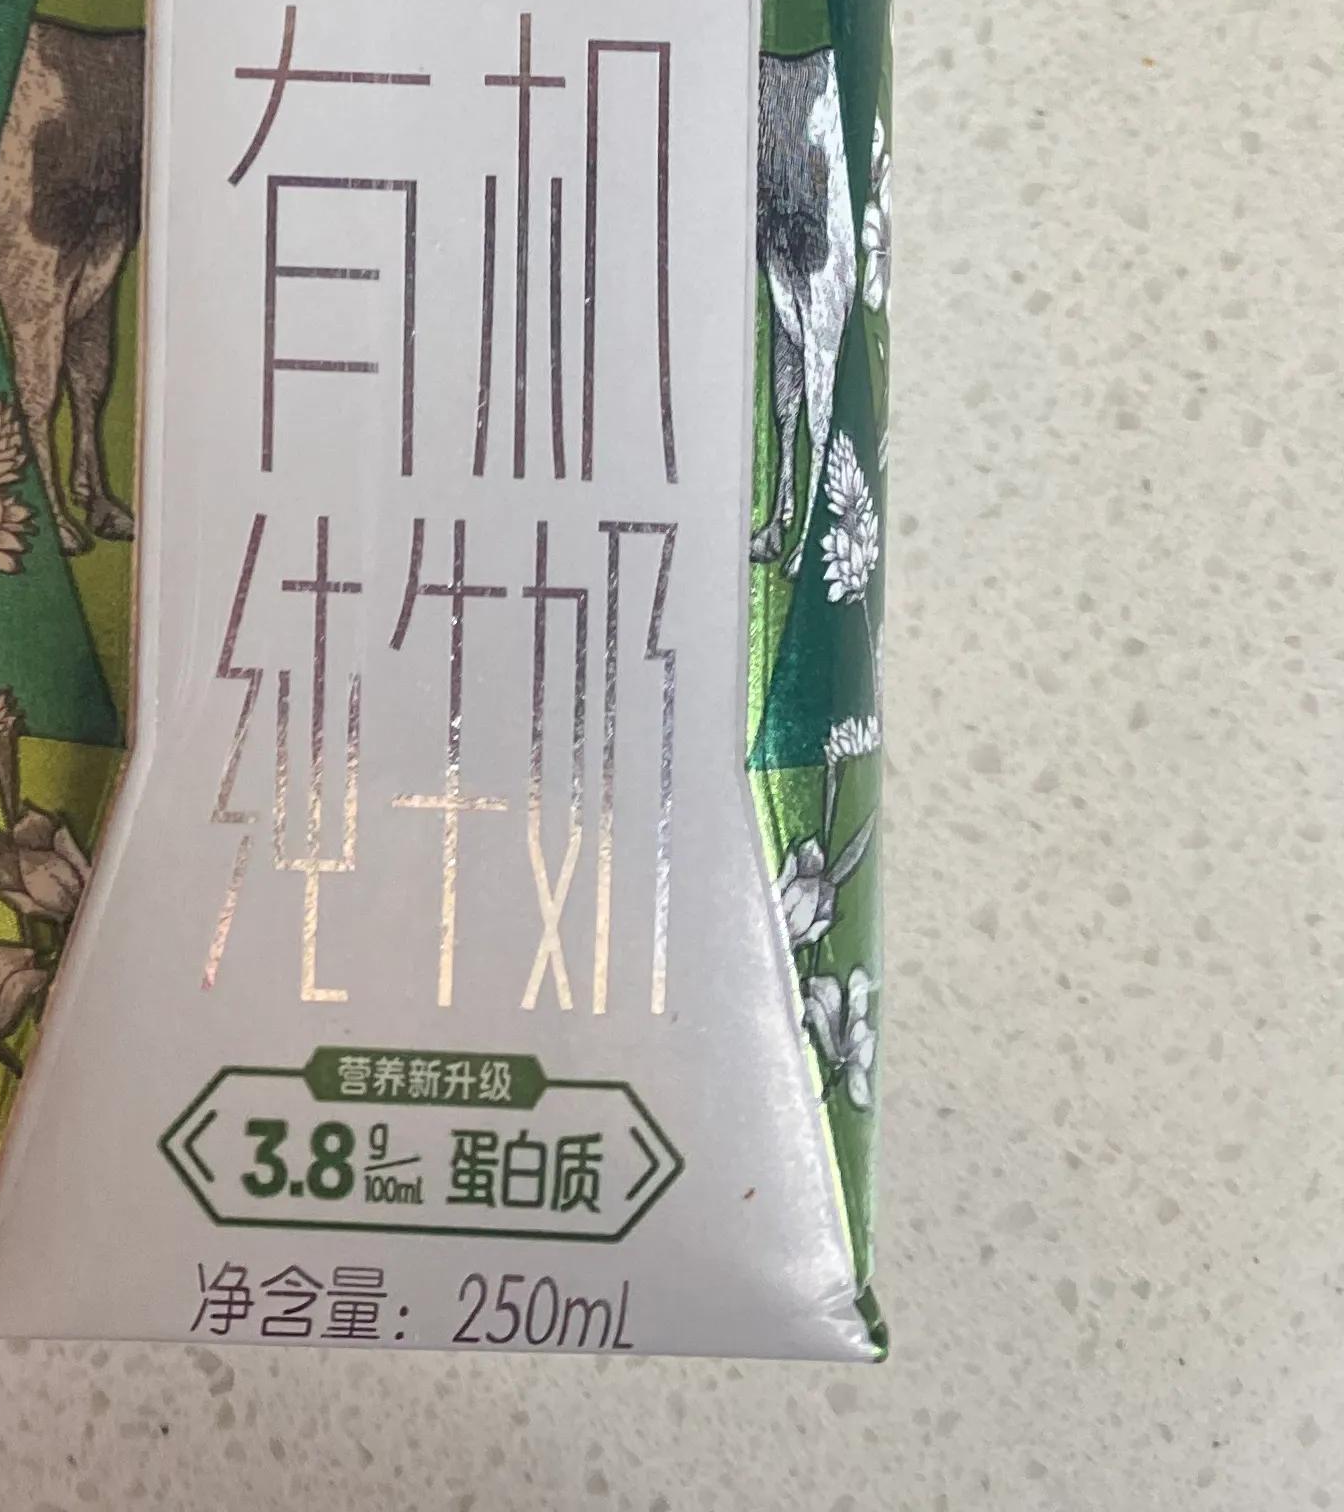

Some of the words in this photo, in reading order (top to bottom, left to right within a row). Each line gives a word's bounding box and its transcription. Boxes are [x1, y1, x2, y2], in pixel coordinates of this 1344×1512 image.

[228, 5, 679, 485] 有机
[200, 513, 679, 1015] 纯牛奶
[337, 1054, 512, 1102] 营养新升级
[241, 1118, 357, 1201] 3.8
[446, 1128, 604, 1215] 蛋白质
[451, 1272, 635, 1351] 250mL
